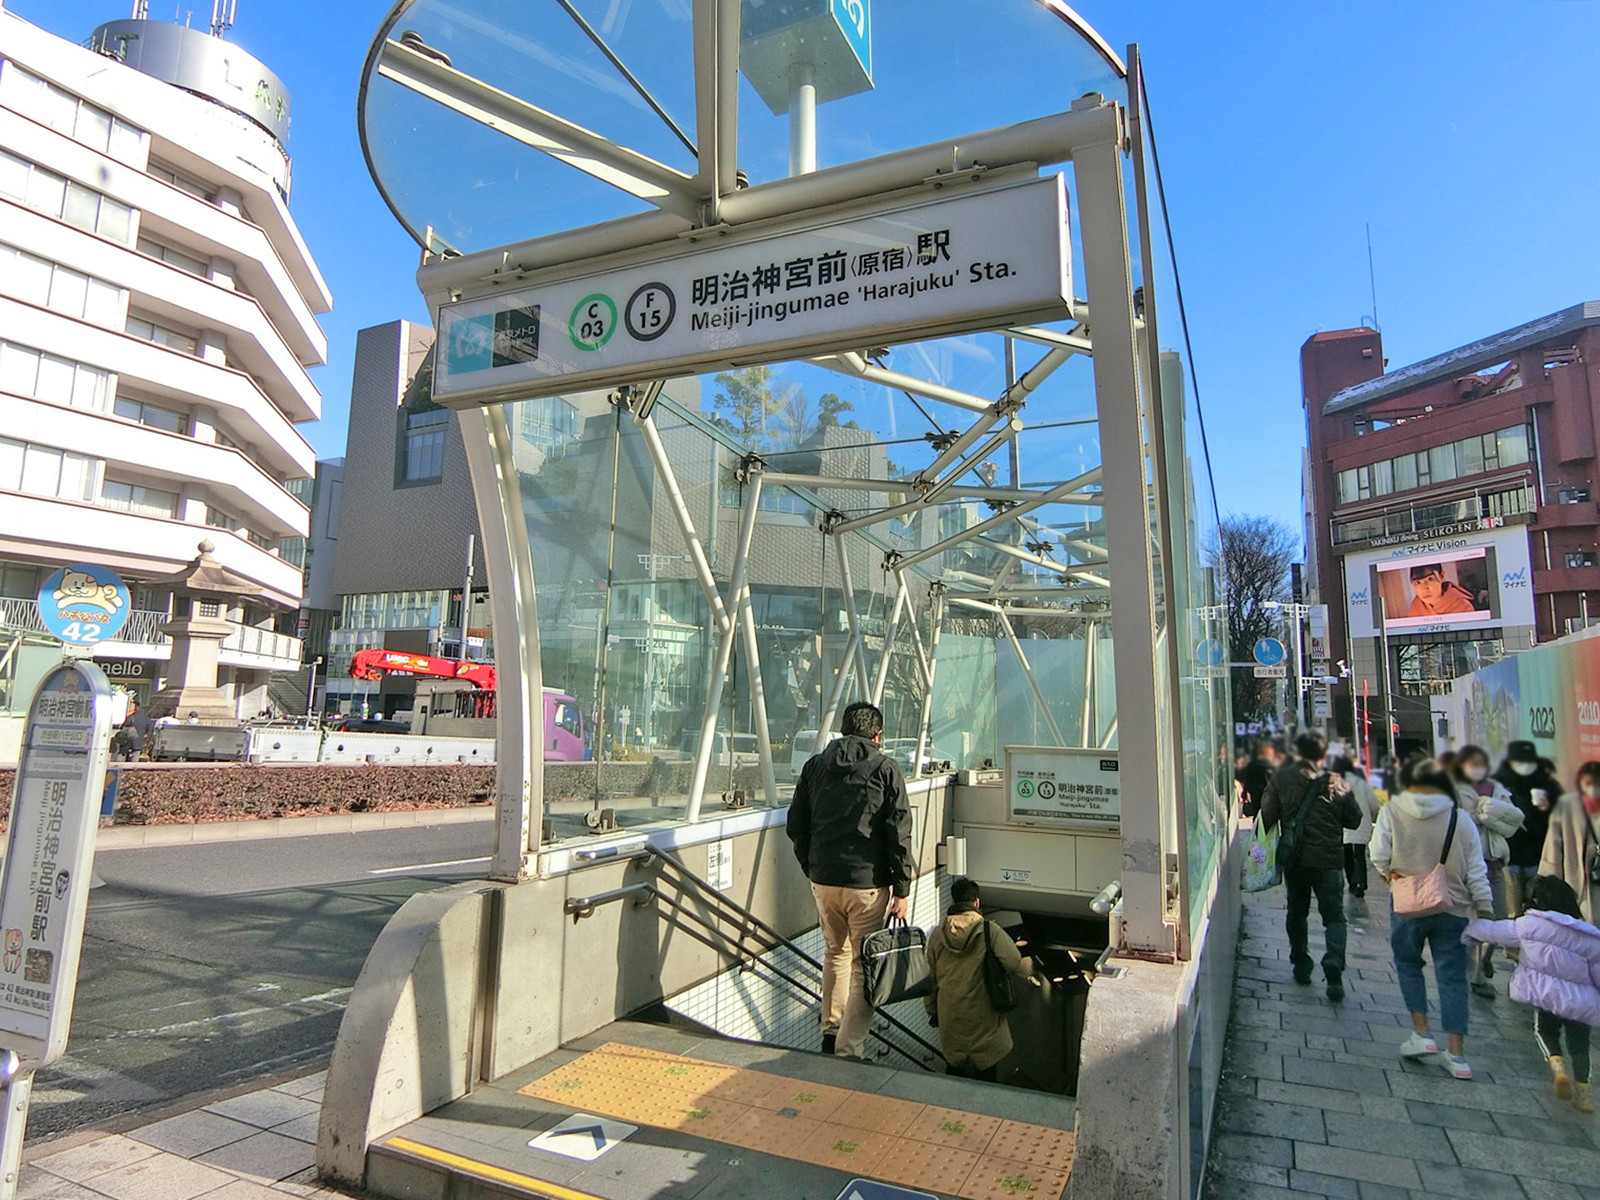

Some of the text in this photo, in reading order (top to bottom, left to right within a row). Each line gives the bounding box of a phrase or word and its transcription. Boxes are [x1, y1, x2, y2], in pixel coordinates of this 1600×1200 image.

[646, 292, 655, 309] F
[690, 288, 850, 332] Meiji-jingumae
[968, 260, 1017, 284] Sta.
[588, 303, 598, 319] C
[640, 309, 661, 329] 15
[581, 320, 604, 339] 03
[1437, 539, 1467, 550] Vision
[62, 622, 101, 642] 42
[1530, 706, 1556, 739] 2023
[1577, 700, 1600, 725] 2010
[30, 781, 68, 942] 明治神宮前駅
